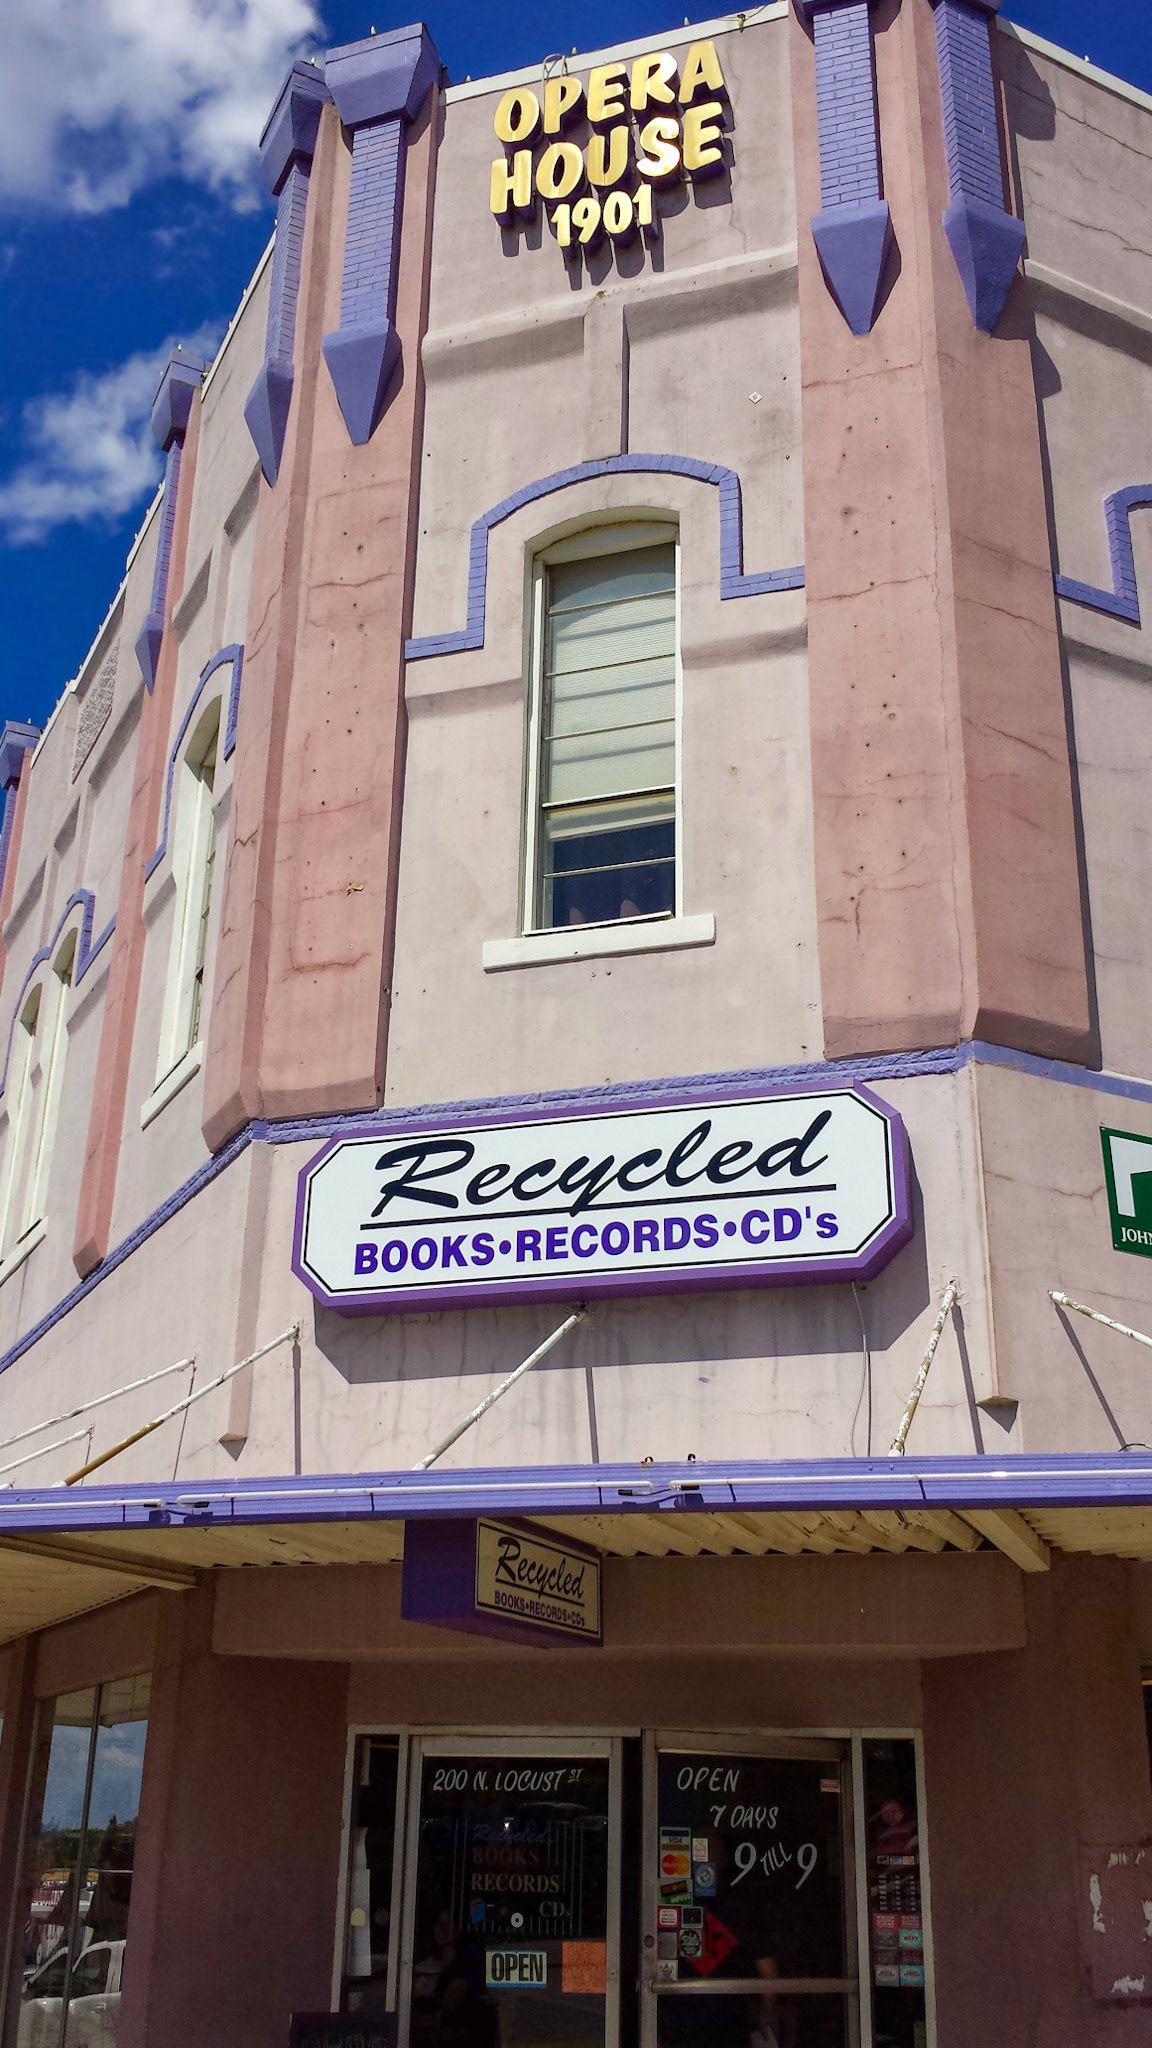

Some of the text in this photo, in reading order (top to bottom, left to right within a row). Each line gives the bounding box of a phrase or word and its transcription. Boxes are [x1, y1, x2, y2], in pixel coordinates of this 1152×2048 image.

[494, 41, 724, 142] OPERA
[490, 102, 722, 213] HOUSE
[551, 184, 651, 246] 1901
[371, 1110, 832, 1217] Recycled
[354, 1232, 493, 1275] BOOKS
[516, 1213, 718, 1262] RECORDS
[495, 1536, 585, 1599] Recycled
[494, 1590, 525, 1611] BOOKS
[529, 1600, 568, 1621] RECORDS
[433, 1769, 584, 1791] 200 N. LOCUST ST
[677, 1767, 740, 1792] OPEN
[709, 1805, 779, 1829] 7 DAYS
[471, 1872, 560, 1893] RECORDS
[730, 1842, 757, 1886] 9
[760, 1841, 793, 1877] TILL
[795, 1842, 818, 1890] 9
[491, 1953, 544, 1982] OPEN
